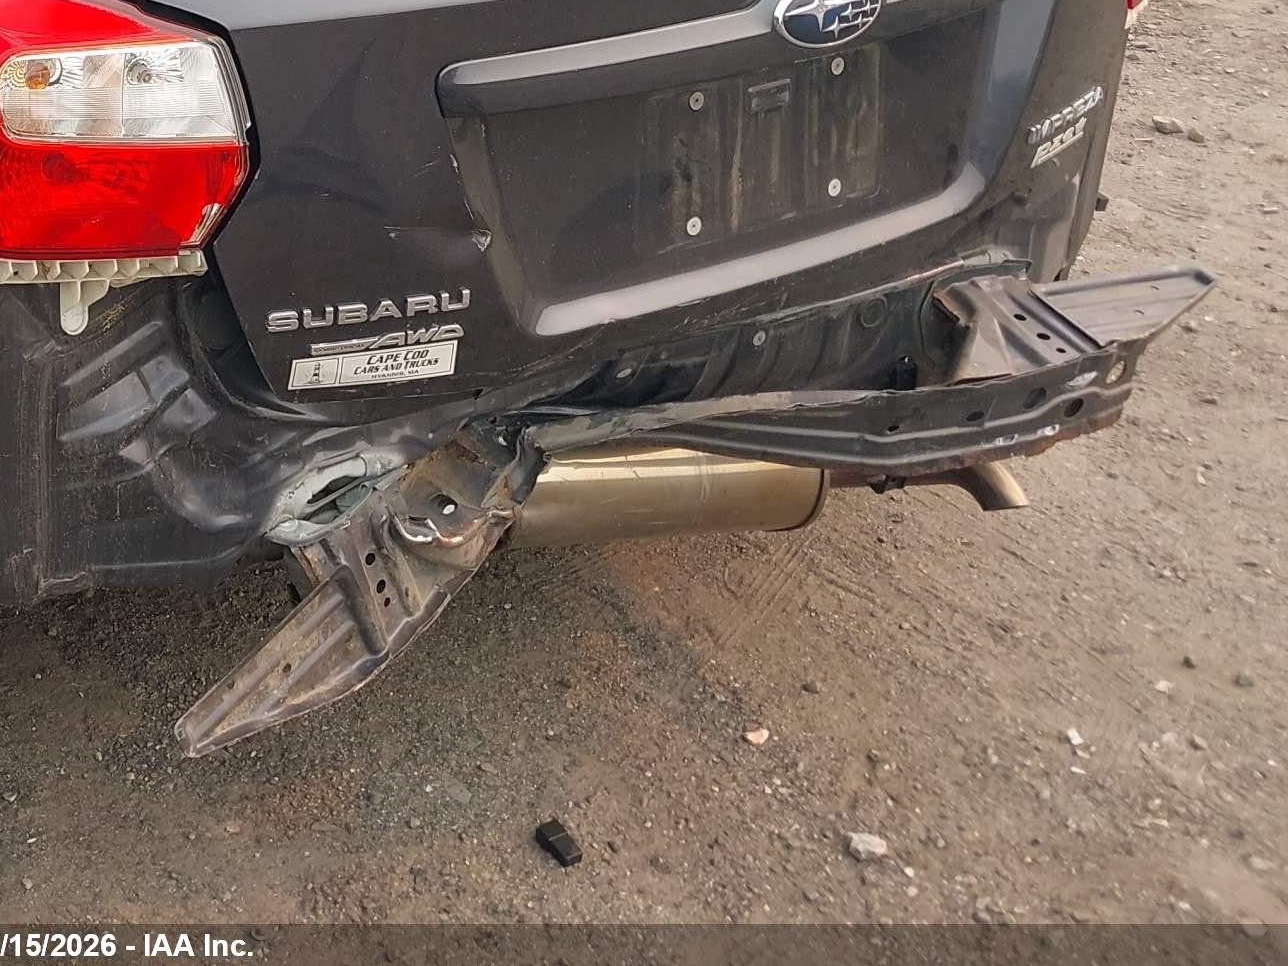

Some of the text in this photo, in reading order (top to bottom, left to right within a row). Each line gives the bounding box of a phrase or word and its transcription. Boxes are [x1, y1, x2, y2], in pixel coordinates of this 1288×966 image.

[266, 287, 471, 333] SUBARU
[368, 323, 464, 350] AWD
[354, 357, 439, 375] CARS AND TRUCKS
[367, 350, 429, 365] CAPE COD
